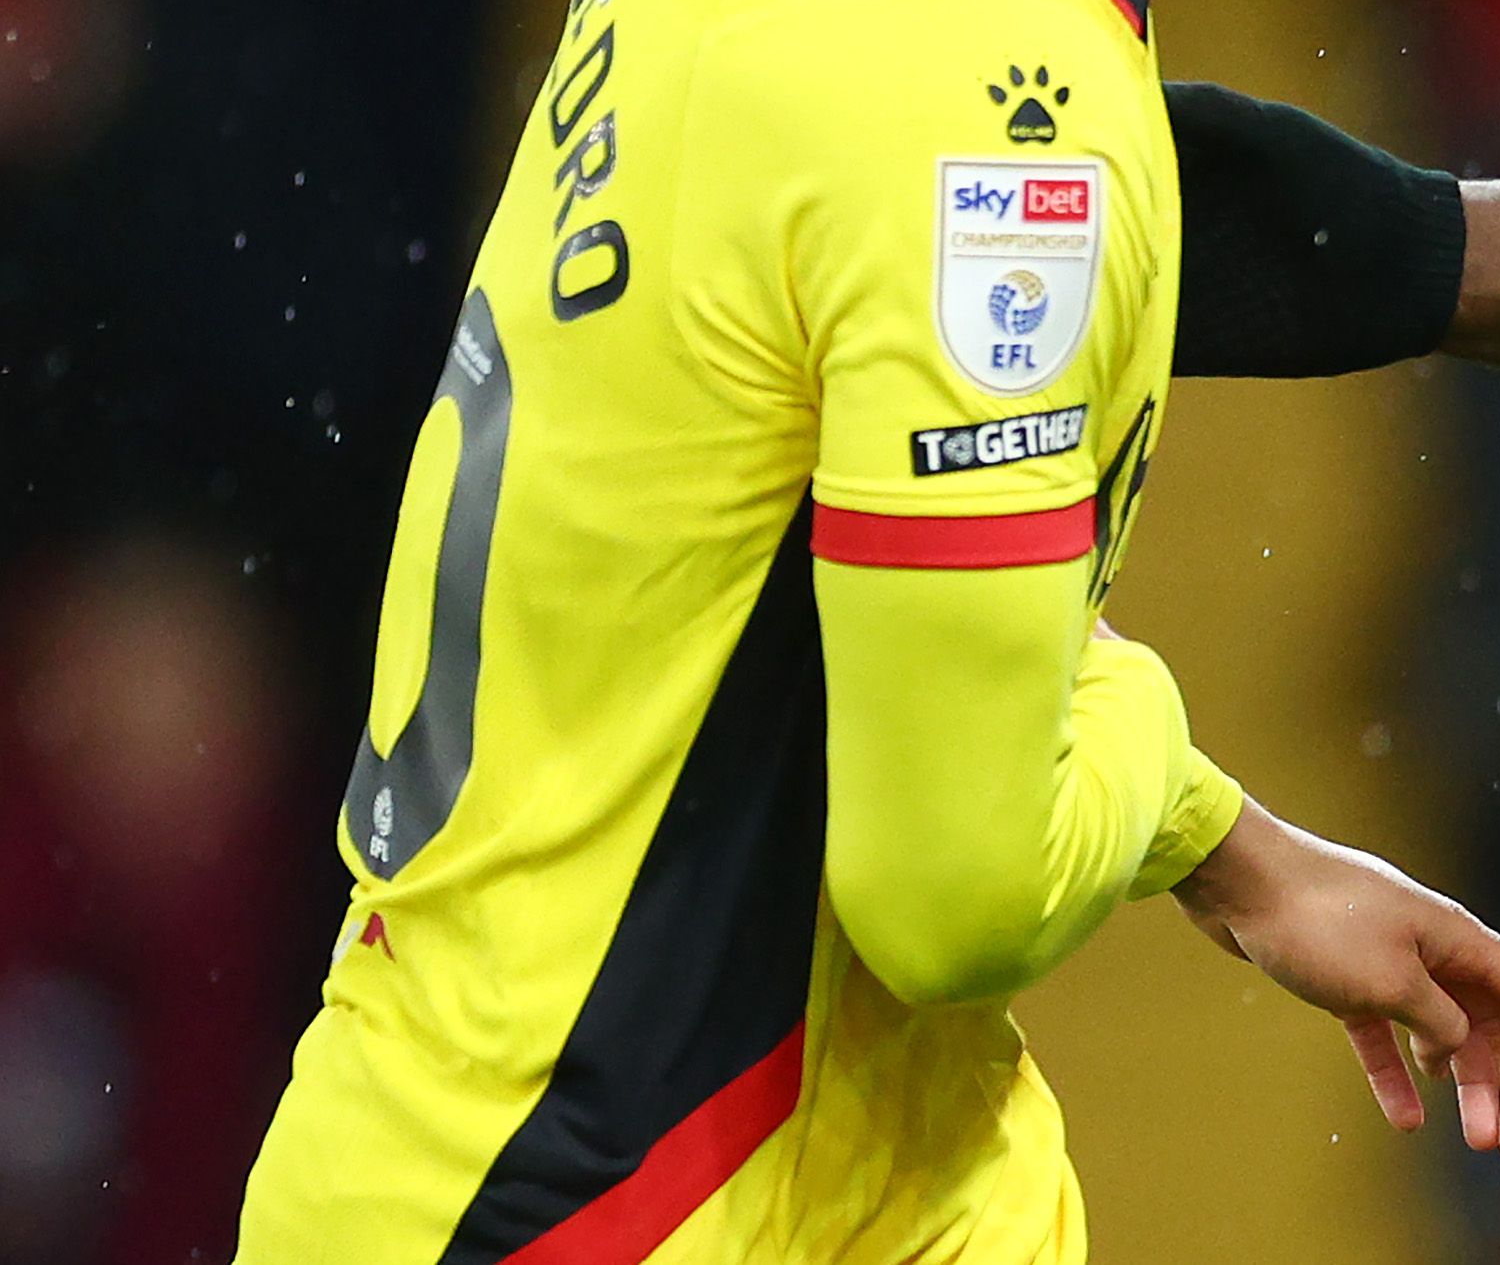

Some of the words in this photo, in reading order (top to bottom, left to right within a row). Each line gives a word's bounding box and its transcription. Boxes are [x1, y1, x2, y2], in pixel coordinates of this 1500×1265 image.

[954, 180, 1016, 220] sky
[1028, 182, 1085, 214] bet
[991, 343, 1036, 369] EFL
